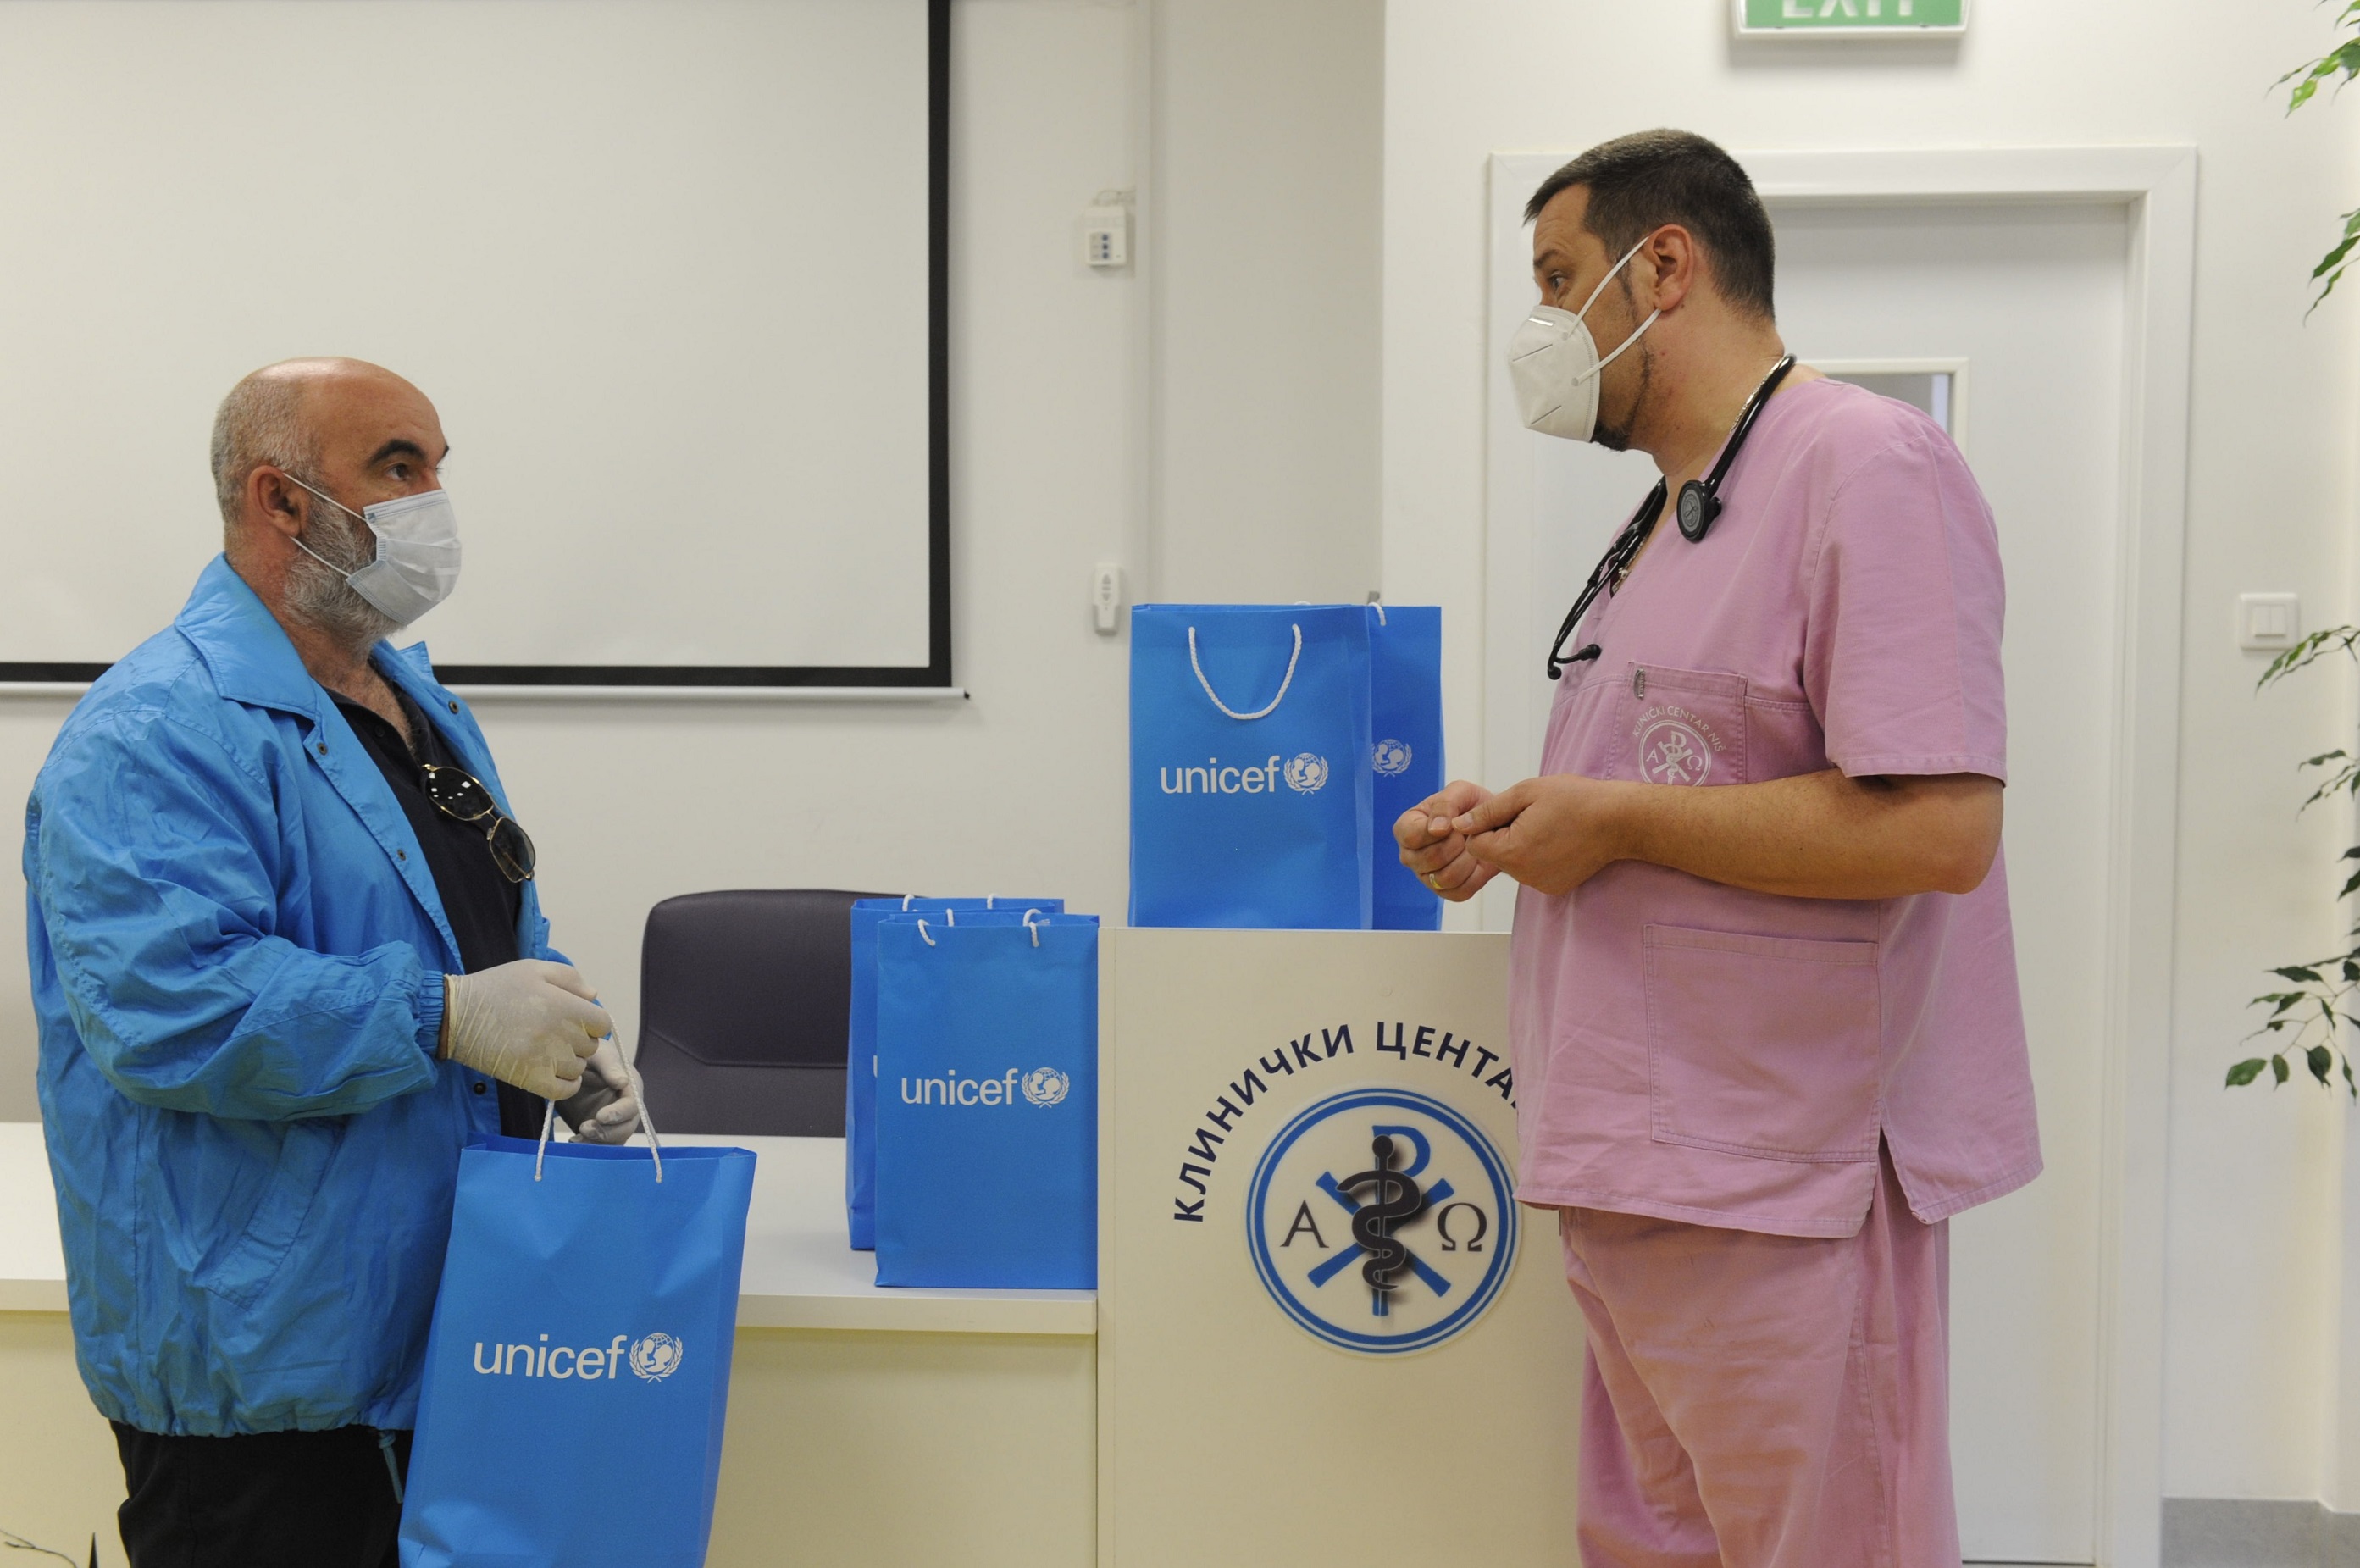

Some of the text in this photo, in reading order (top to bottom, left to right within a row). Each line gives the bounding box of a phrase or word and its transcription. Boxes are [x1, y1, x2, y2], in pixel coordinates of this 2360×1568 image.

[1632, 705, 1727, 752] KLINIČKI CENTAR NIŠ
[1161, 755, 1280, 794] unicef
[901, 1068, 1018, 1105] unicef
[1173, 1022, 1516, 1222] КЛИНИЧКИ ЦЕНТА
[473, 1333, 628, 1380] unicef
